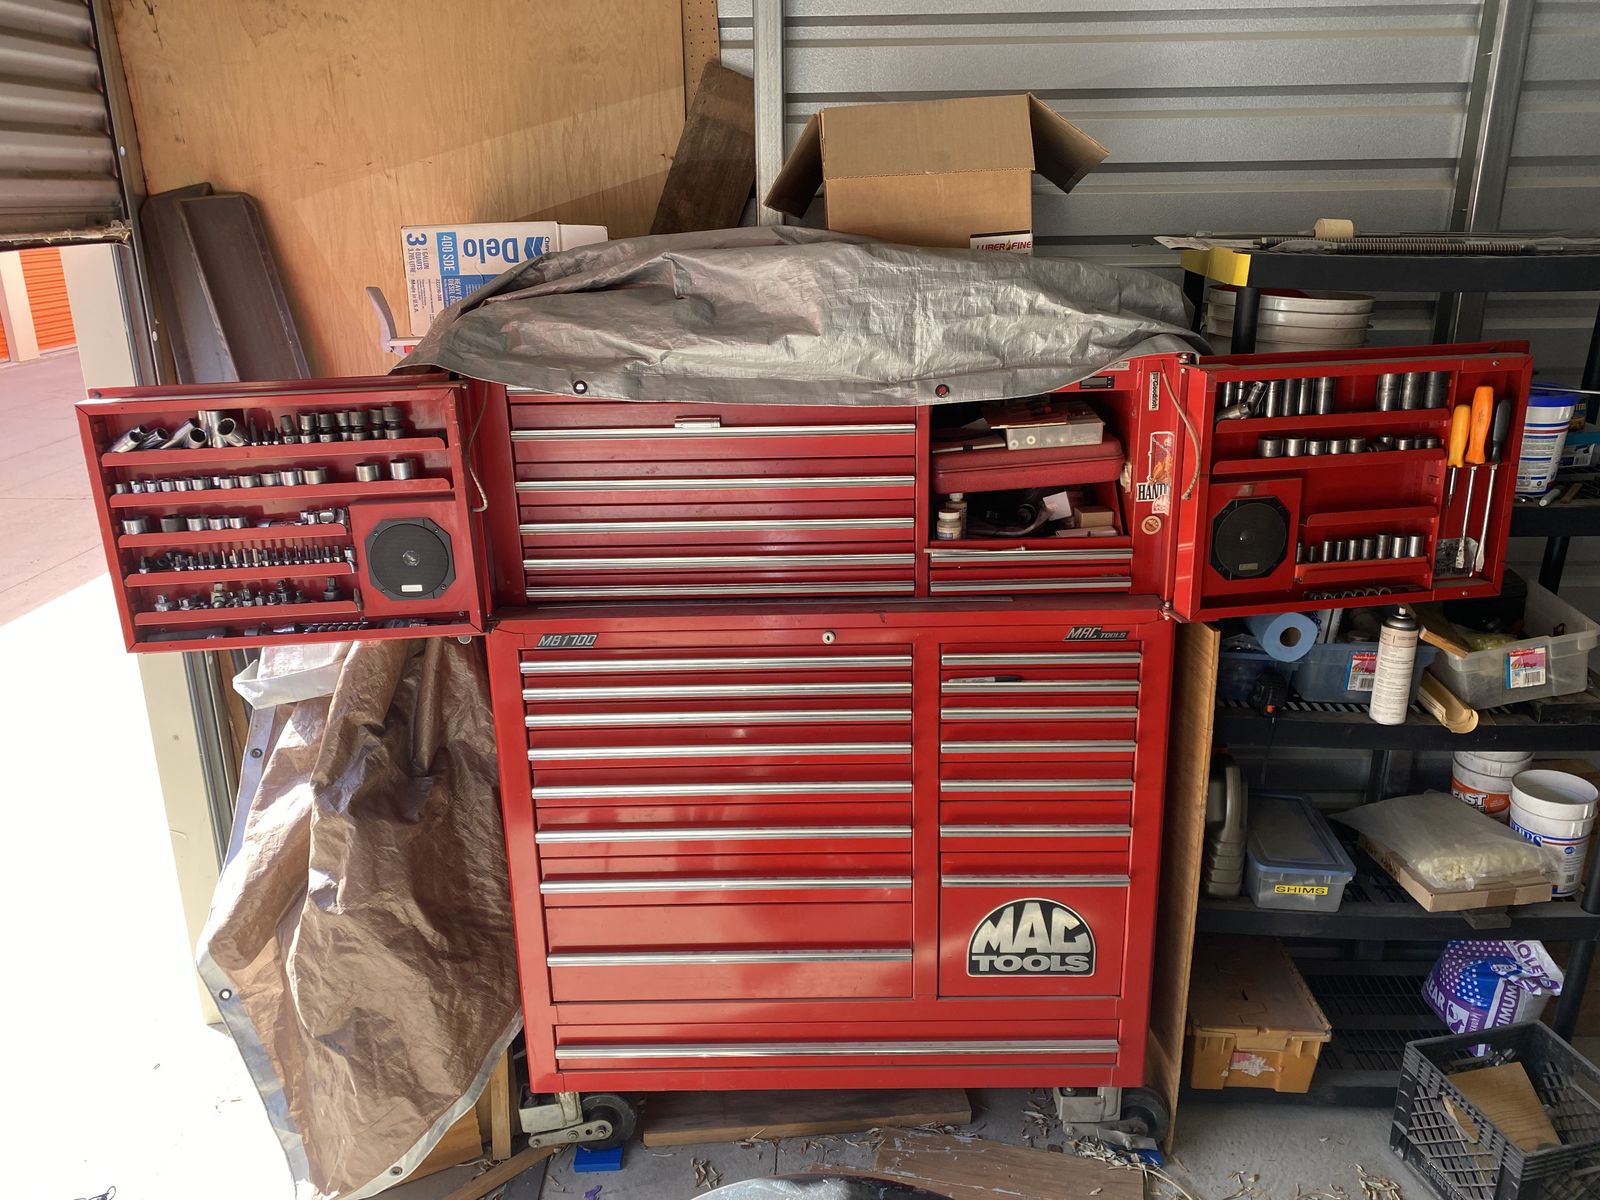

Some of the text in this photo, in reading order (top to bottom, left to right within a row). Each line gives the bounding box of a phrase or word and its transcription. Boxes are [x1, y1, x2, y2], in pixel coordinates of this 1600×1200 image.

[406, 233, 427, 246] 3
[441, 235, 454, 253] 400
[463, 237, 519, 263] Delo
[415, 252, 423, 271] QUARTS
[422, 251, 430, 270] GALLON
[443, 254, 456, 271] SDE
[1066, 627, 1101, 639] MAC
[1276, 886, 1325, 894] SHIMS
[972, 902, 1091, 953] MAC
[972, 955, 1090, 972] TOOLS
